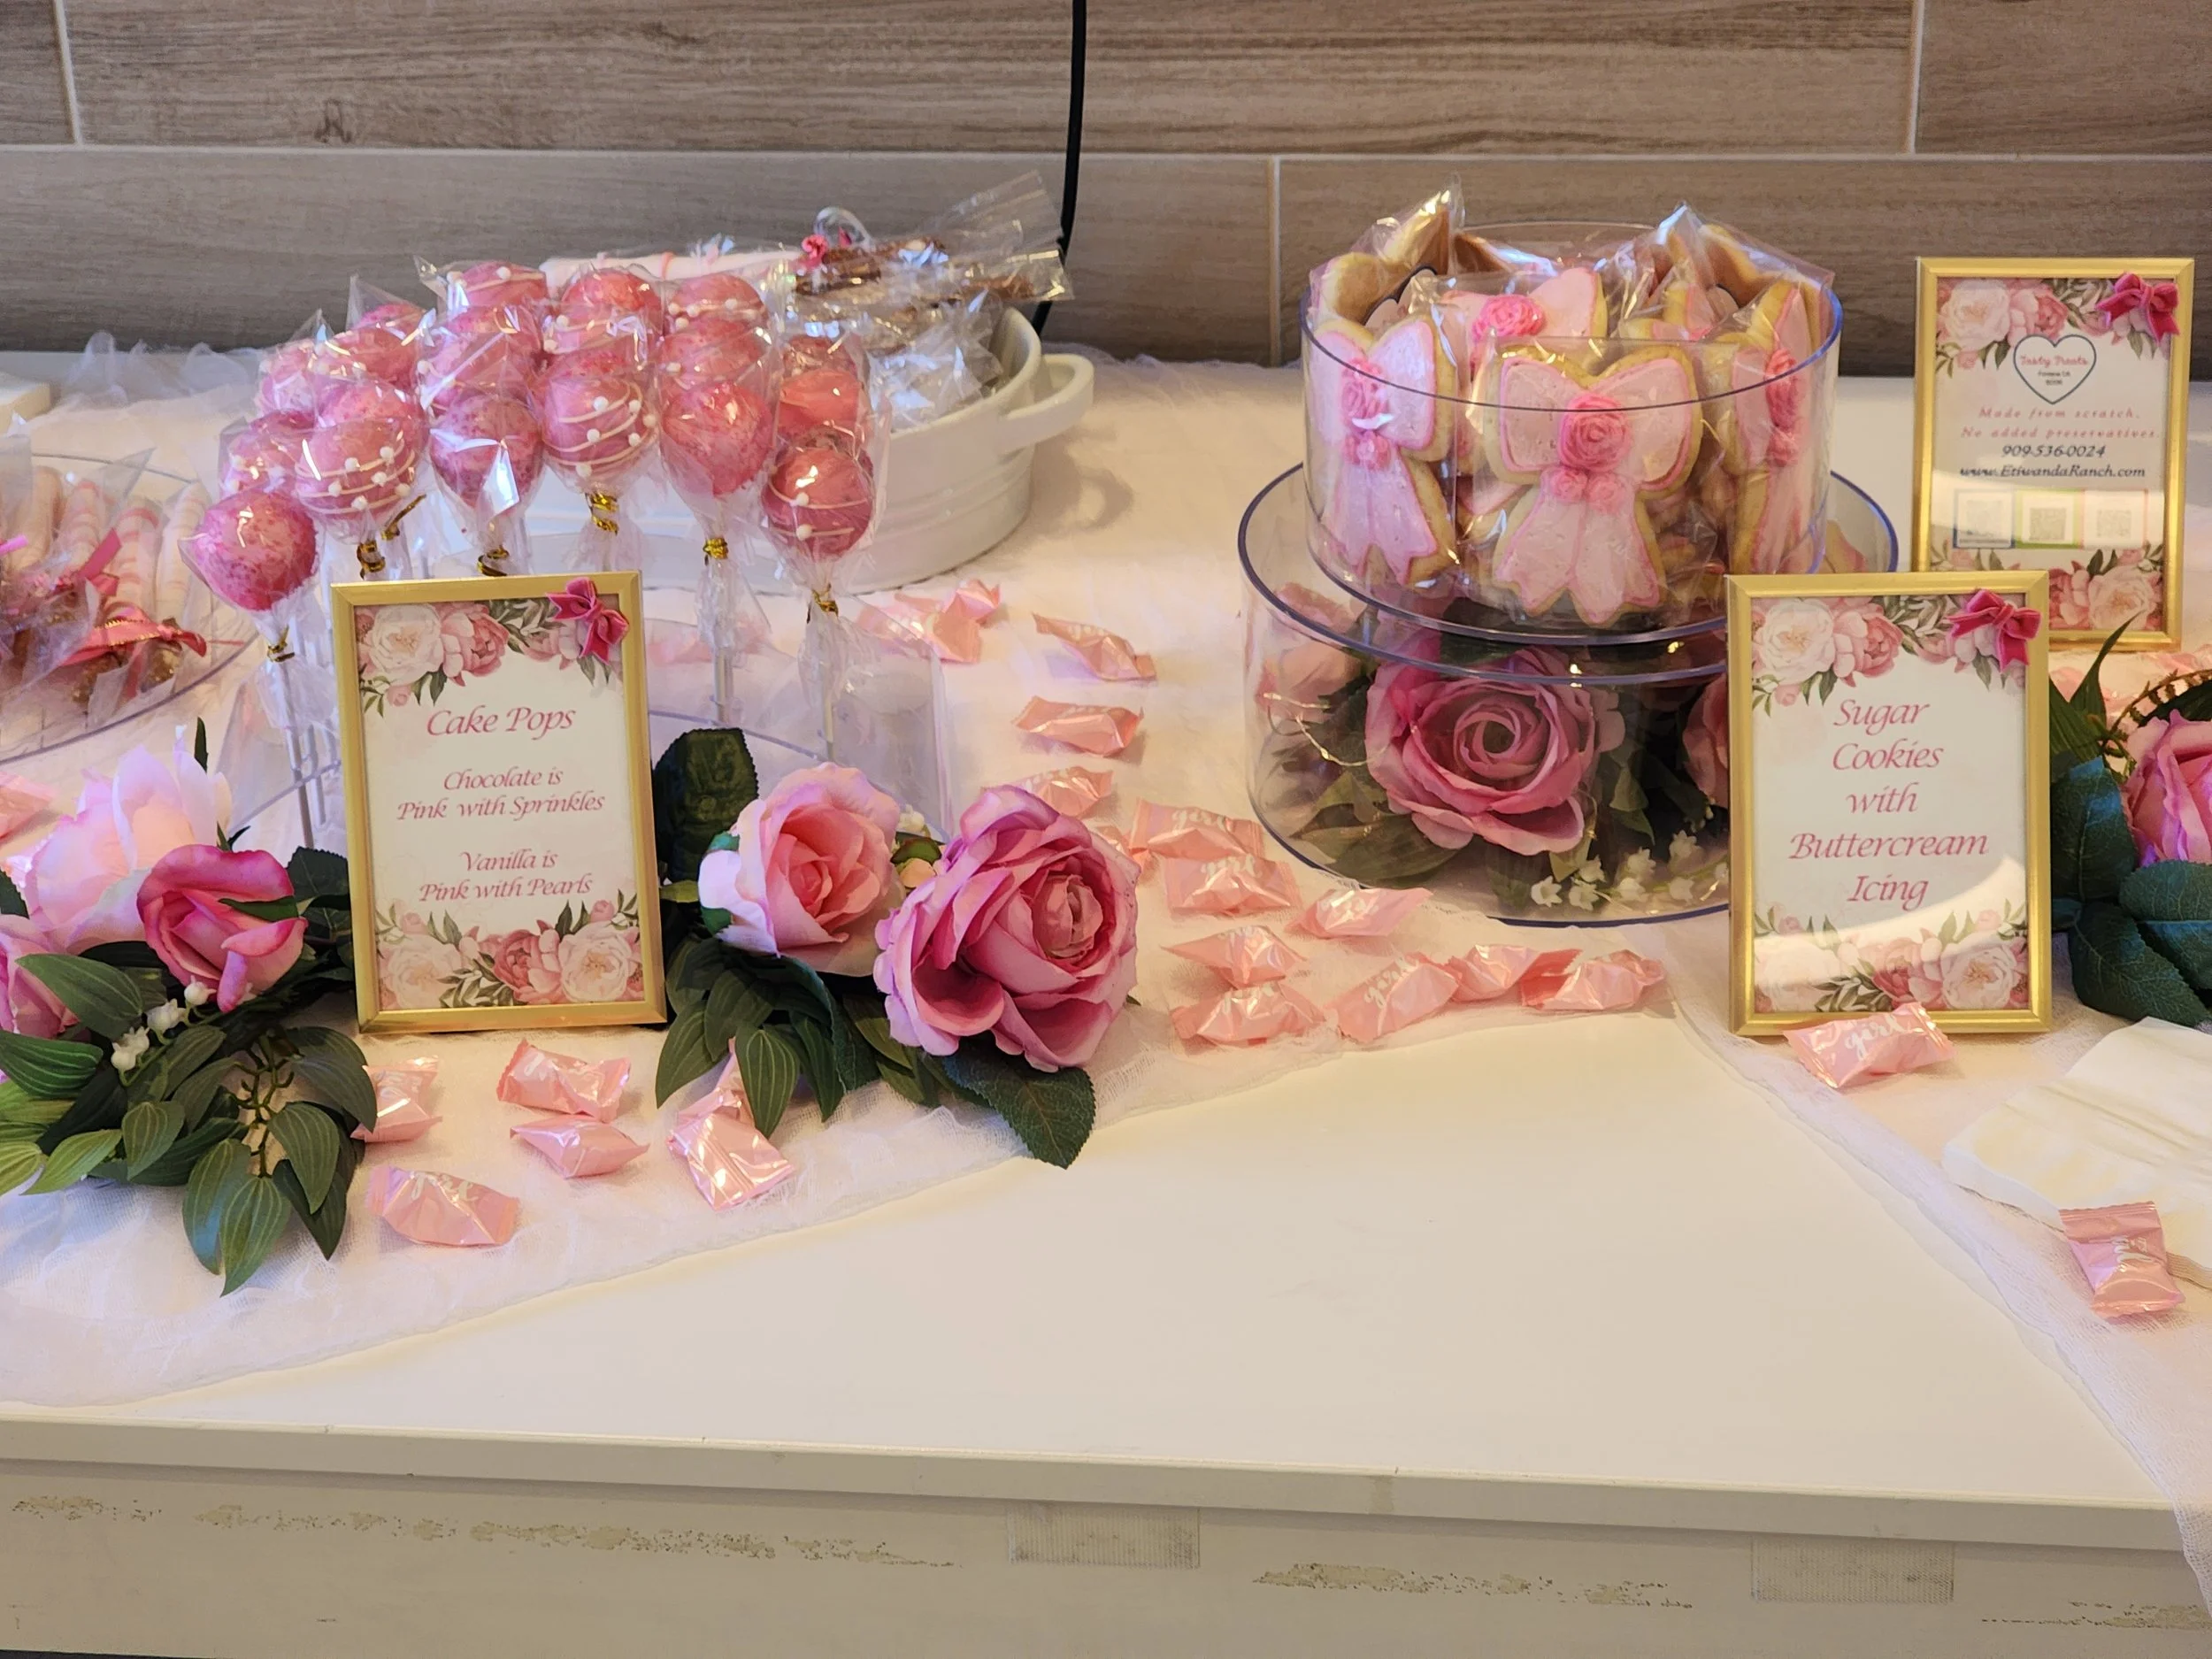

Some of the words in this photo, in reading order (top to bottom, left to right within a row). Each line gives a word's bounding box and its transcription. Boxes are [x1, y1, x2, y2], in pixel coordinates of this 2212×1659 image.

[1978, 407, 2022, 419] Made
[2028, 407, 2066, 420] from
[2075, 406, 2140, 419] scratch.
[1960, 426, 1982, 438] No
[1991, 426, 2039, 439] added
[2045, 426, 2161, 440] preservatives.
[1959, 464, 2146, 478] www.EtiwandaRanch.com
[426, 705, 499, 737] Cake
[505, 706, 577, 741] Pops
[1832, 698, 1931, 736] Sugar
[1832, 738, 1945, 771] Cookies
[443, 765, 542, 791] Chocolate
[547, 766, 564, 786] is
[396, 797, 449, 821] Pink
[456, 794, 507, 818] with
[510, 789, 606, 822] Sprinkles
[1845, 781, 1919, 814] with
[458, 848, 537, 872] Vanilla
[541, 849, 559, 869] is
[1787, 833, 1990, 859] Buttercream
[419, 879, 471, 902] Pink
[474, 875, 524, 899] with
[526, 872, 594, 897] Pearls
[1847, 873, 1930, 912] Icing
[1844, 1013, 1908, 1063] girl
